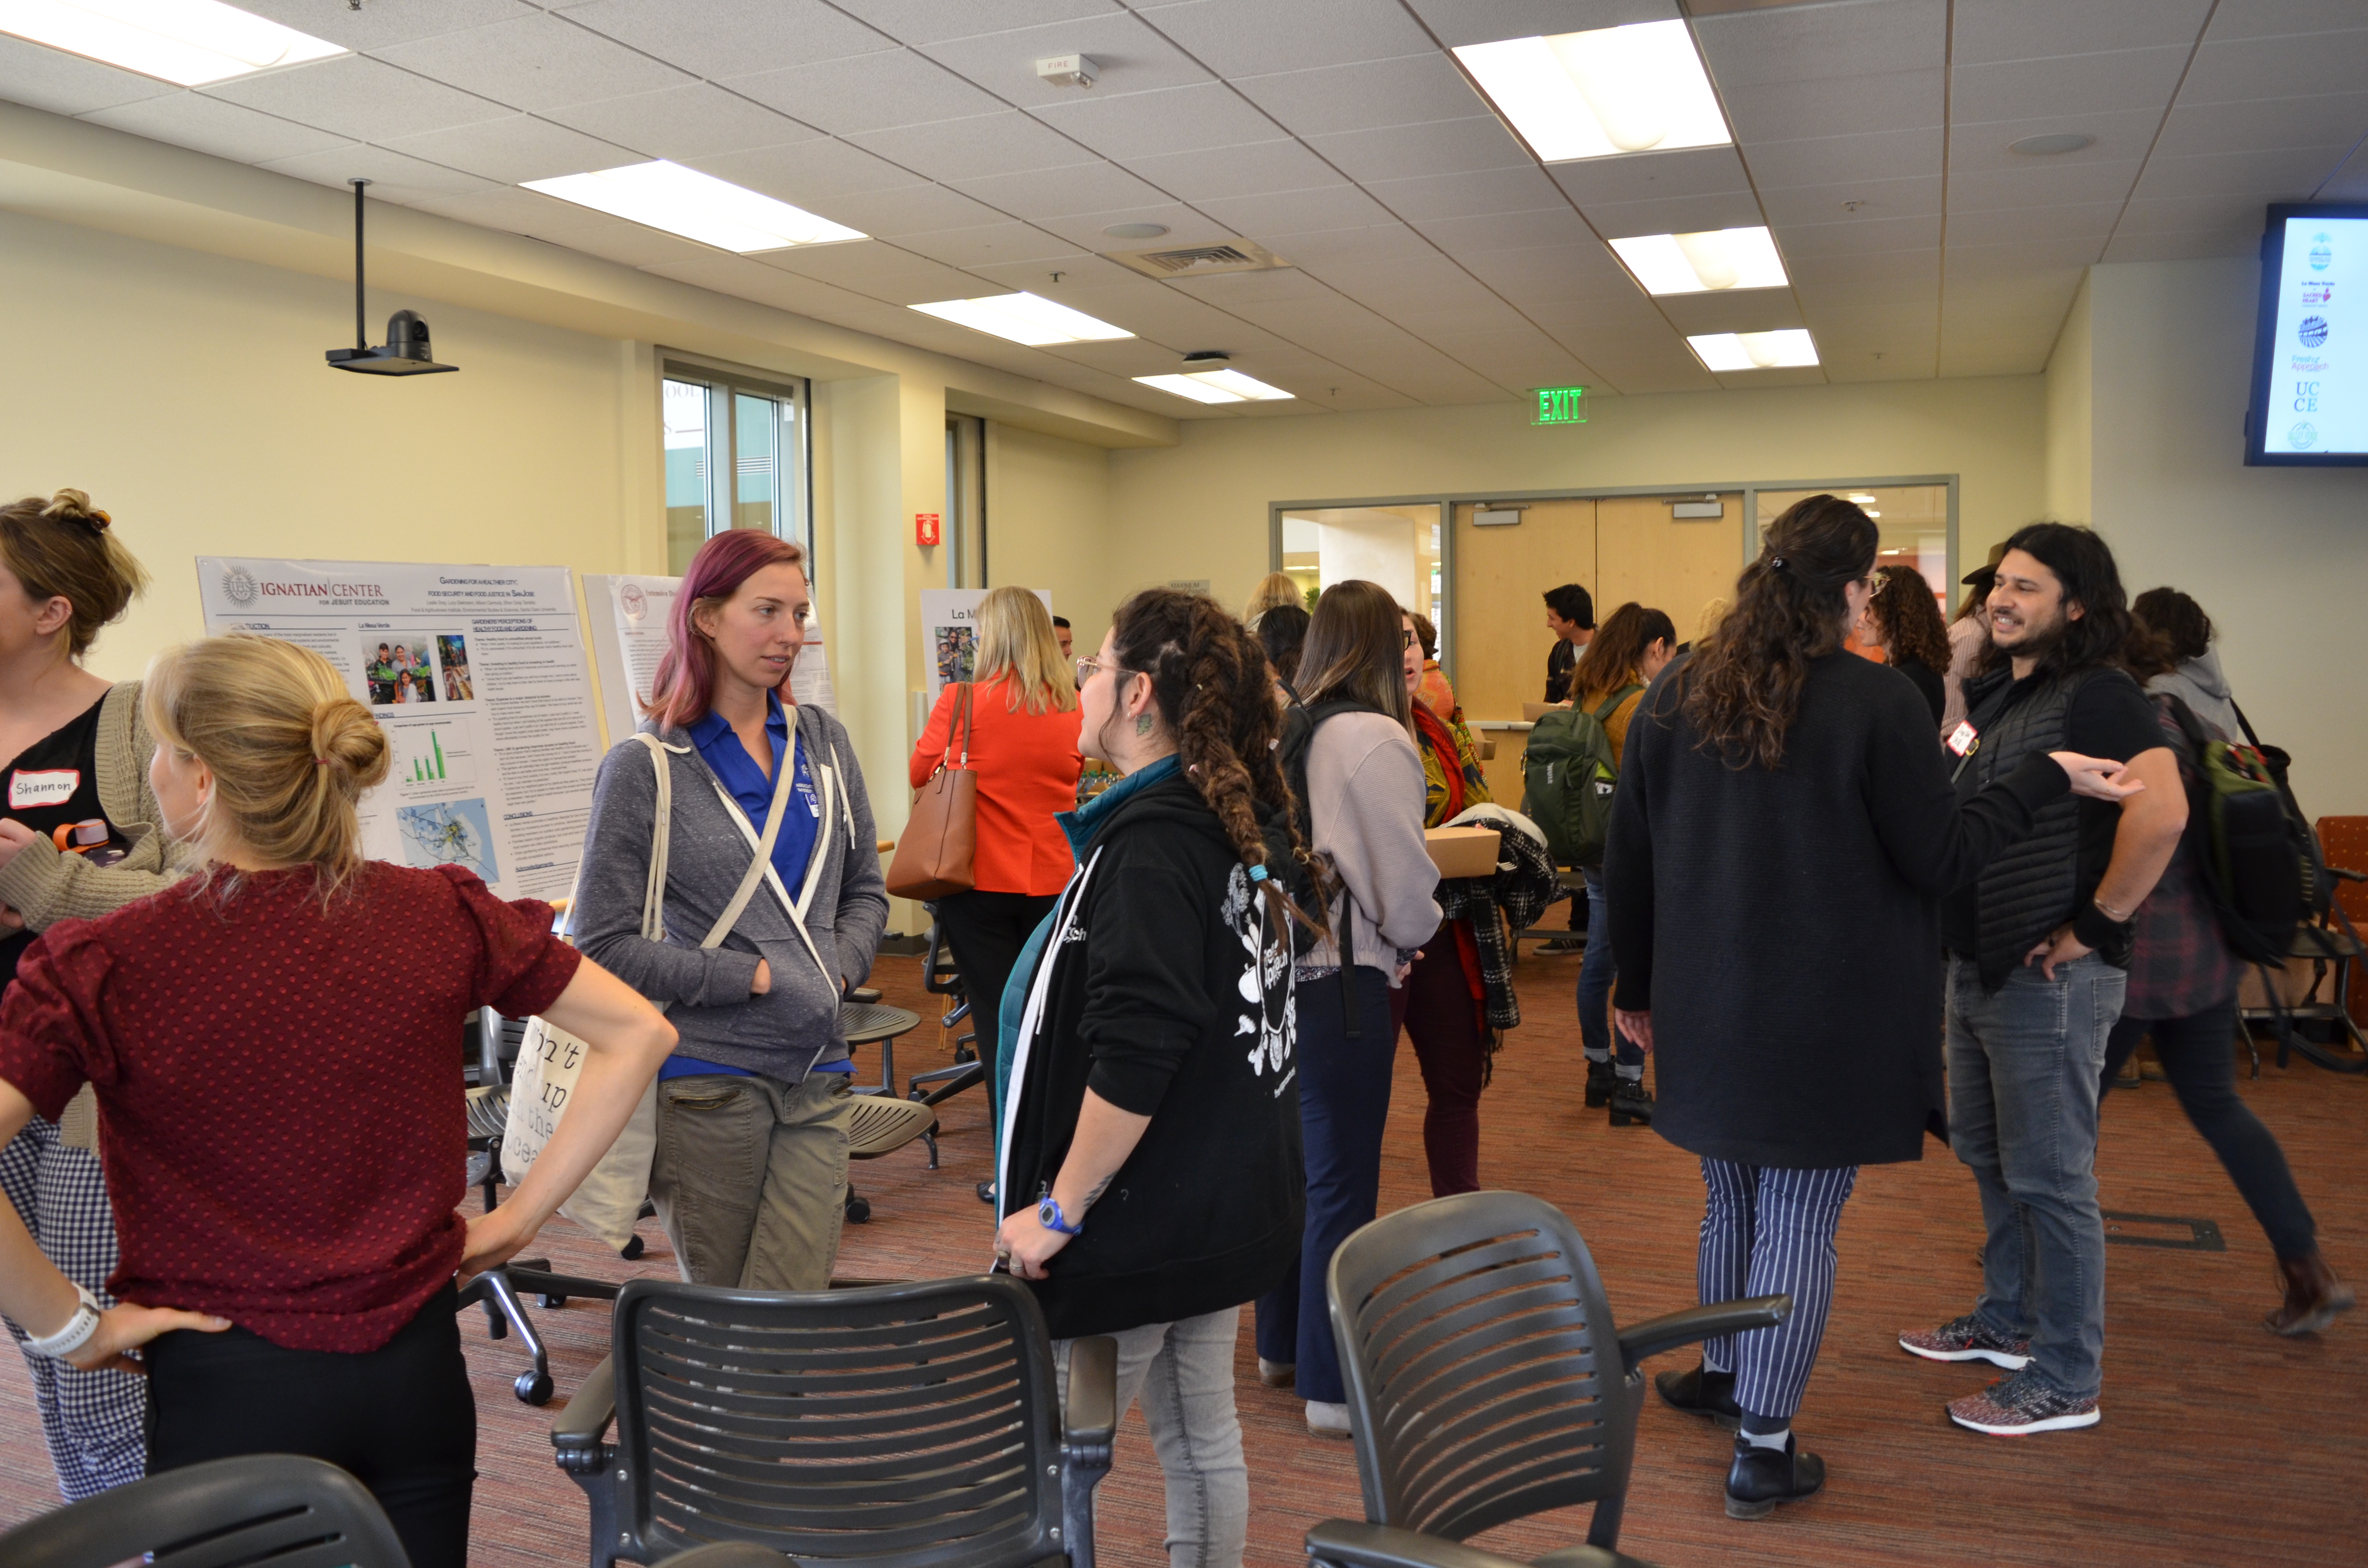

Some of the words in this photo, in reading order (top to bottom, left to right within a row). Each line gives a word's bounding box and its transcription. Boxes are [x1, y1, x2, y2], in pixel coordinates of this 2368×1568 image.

[1048, 61, 1068, 69] FIRE
[2292, 362, 2329, 372] Approach
[1540, 389, 1582, 421] EXIT
[260, 582, 328, 596] IGNATIAN
[332, 584, 384, 597] CENTER
[952, 609, 964, 619] La
[16, 783, 71, 794] Shannon
[504, 811, 533, 820] CONCLUSIONS
